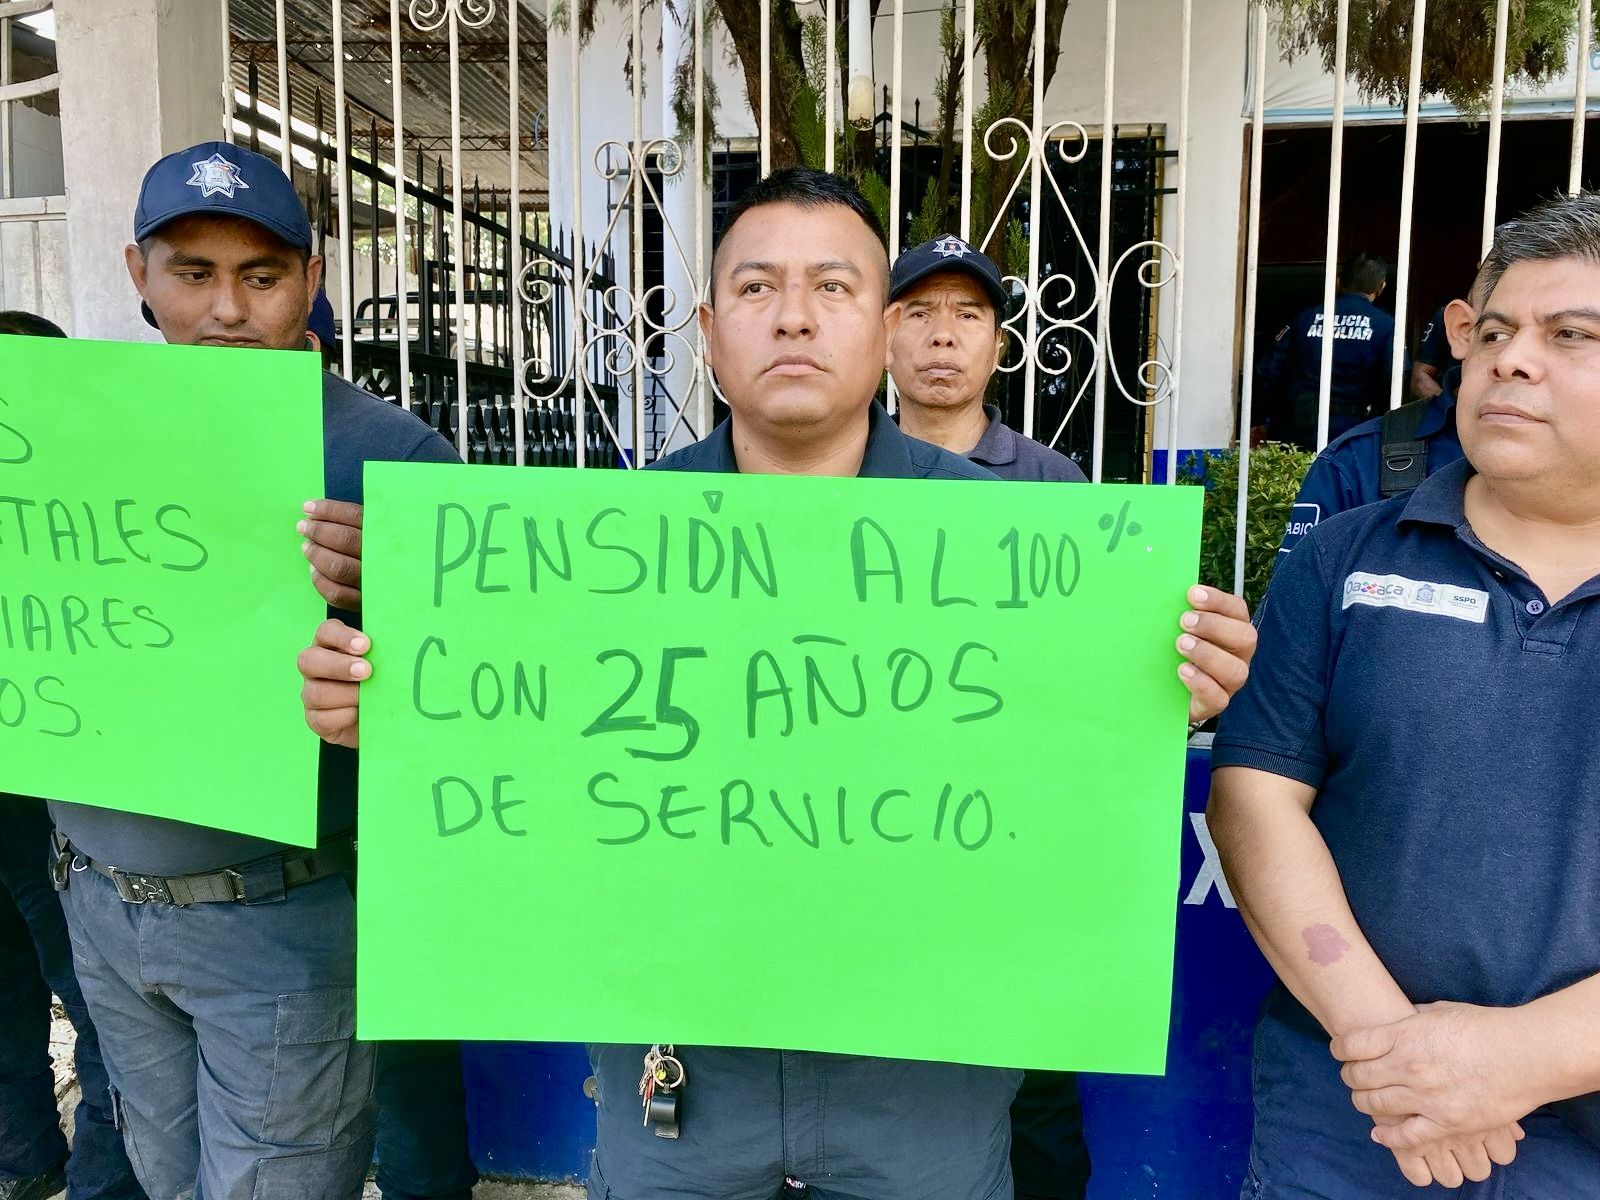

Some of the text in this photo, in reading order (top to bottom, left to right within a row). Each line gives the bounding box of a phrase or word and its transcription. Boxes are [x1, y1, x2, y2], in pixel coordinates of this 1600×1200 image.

[1313, 313, 1370, 327] PLICIA
[0, 495, 209, 572] TALES
[433, 490, 778, 608] PENSIÓN
[850, 516, 978, 608] AL
[0, 593, 175, 655] IARES
[412, 634, 1004, 762] CON 25 AÑOS
[431, 771, 1016, 852] DE SERVICIO.
